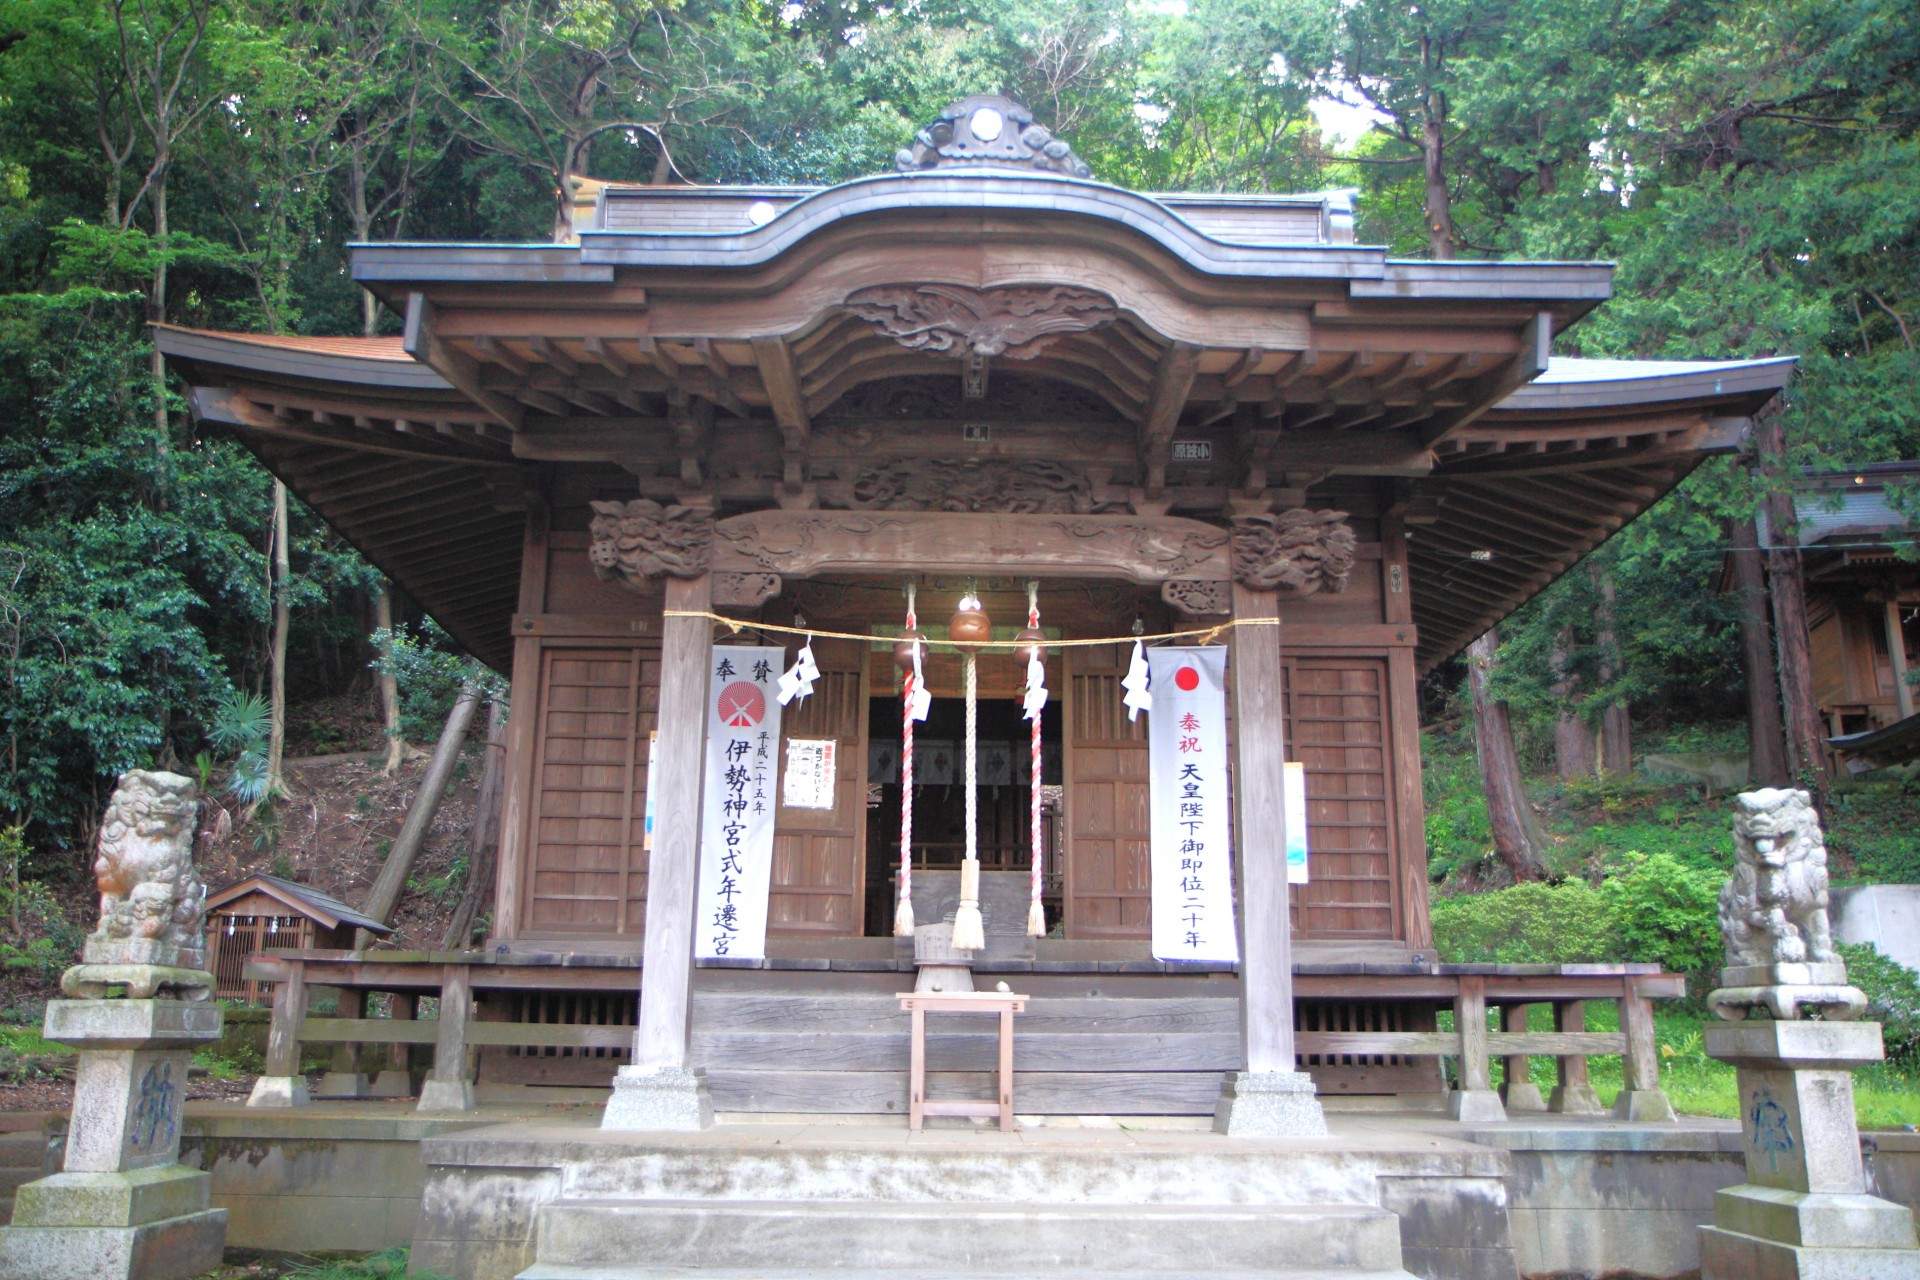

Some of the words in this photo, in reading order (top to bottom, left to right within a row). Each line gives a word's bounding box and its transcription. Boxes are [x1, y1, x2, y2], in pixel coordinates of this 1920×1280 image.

[752, 731, 771, 816] 平成二十五年
[1178, 712, 1202, 754] 奉祝
[712, 738, 752, 956] 伊勢神宮式年遷宮
[1178, 763, 1207, 949] 天皇陛下御即位二十年
